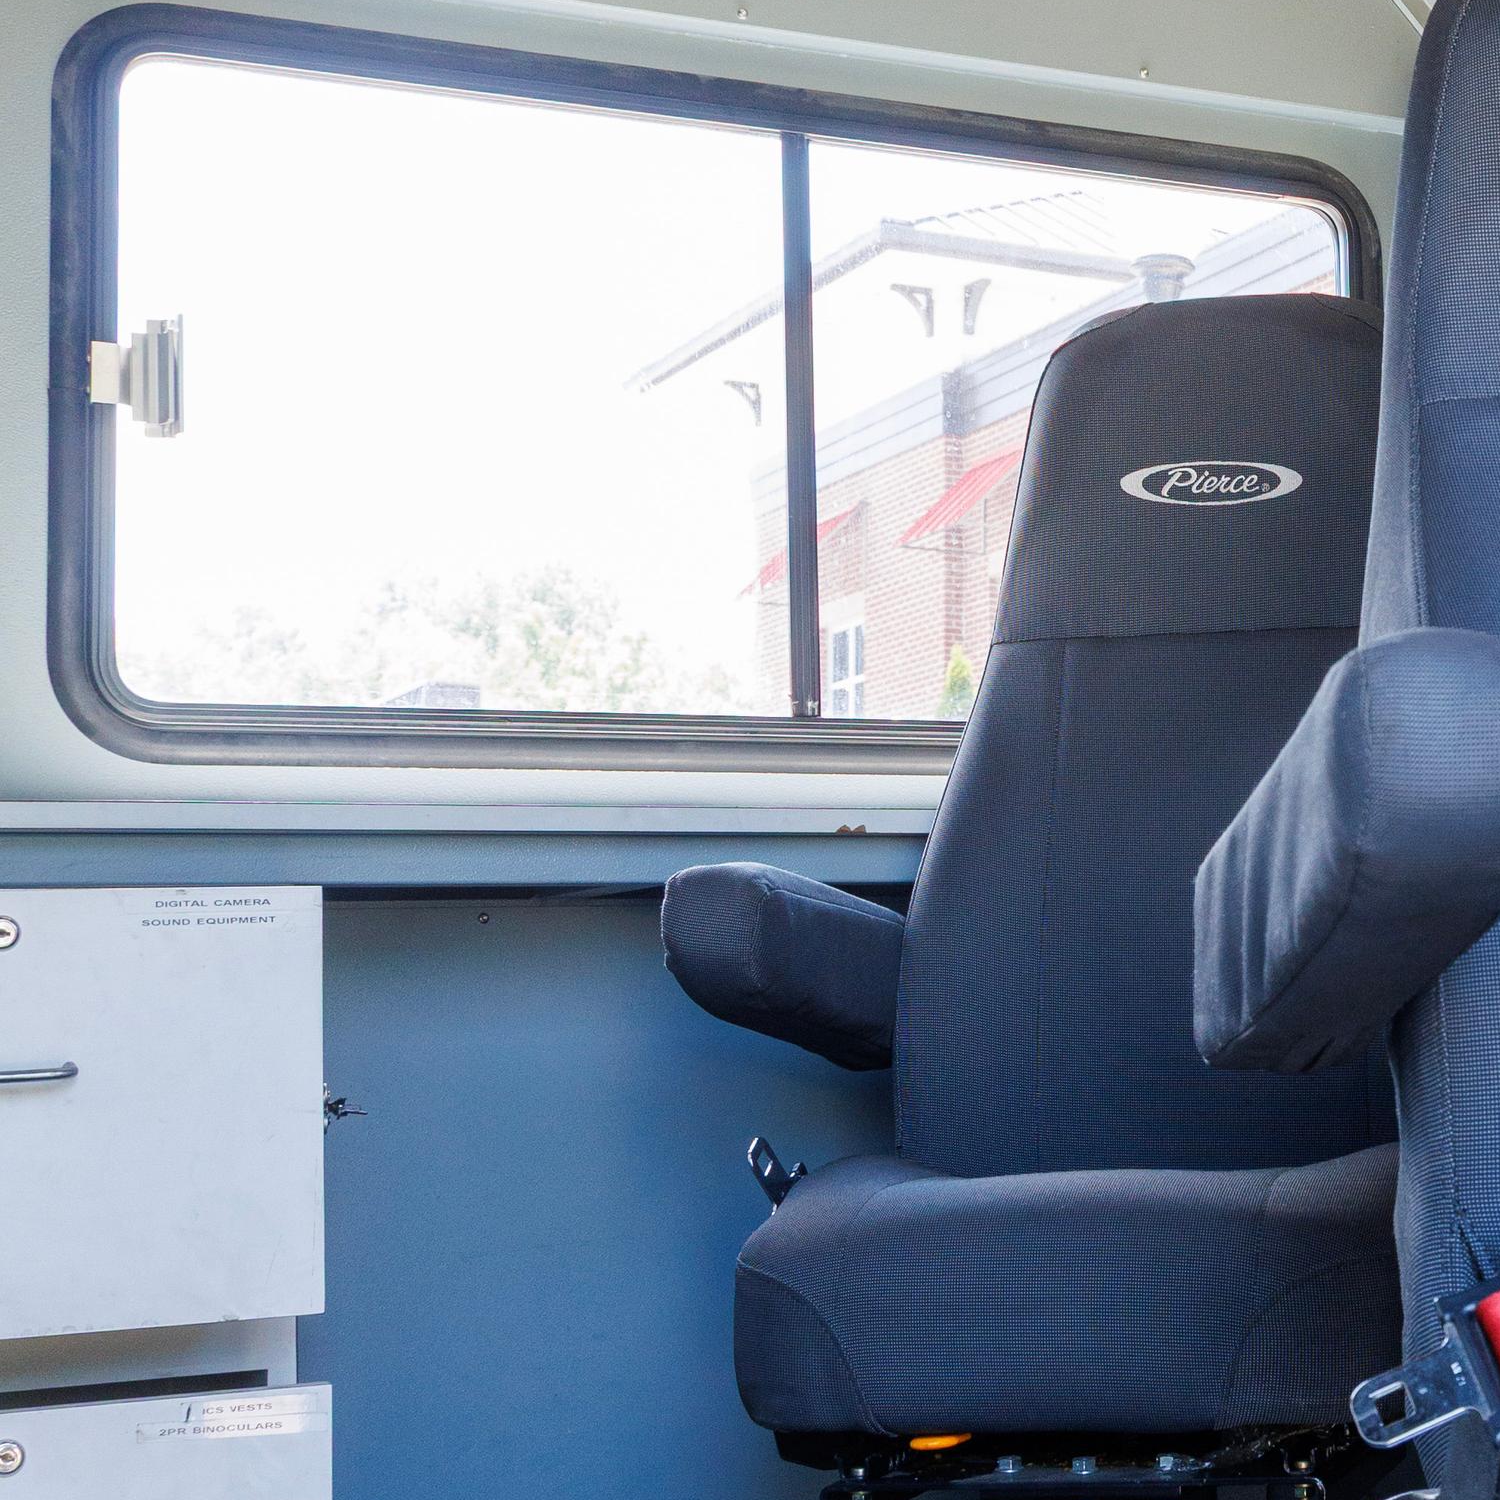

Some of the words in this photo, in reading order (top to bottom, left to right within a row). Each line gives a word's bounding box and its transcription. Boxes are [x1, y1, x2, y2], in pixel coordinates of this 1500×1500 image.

[1161, 467, 1260, 498] Pierce
[155, 900, 209, 908] DIGITAL
[213, 898, 272, 907] CAMERA
[141, 918, 191, 927] SOUND
[197, 915, 276, 925] EQUIPMENT
[202, 1405, 224, 1415] ICS
[230, 1402, 273, 1413] VESTS
[159, 1427, 187, 1437] 2PR
[193, 1421, 283, 1435] BINOCULARS
